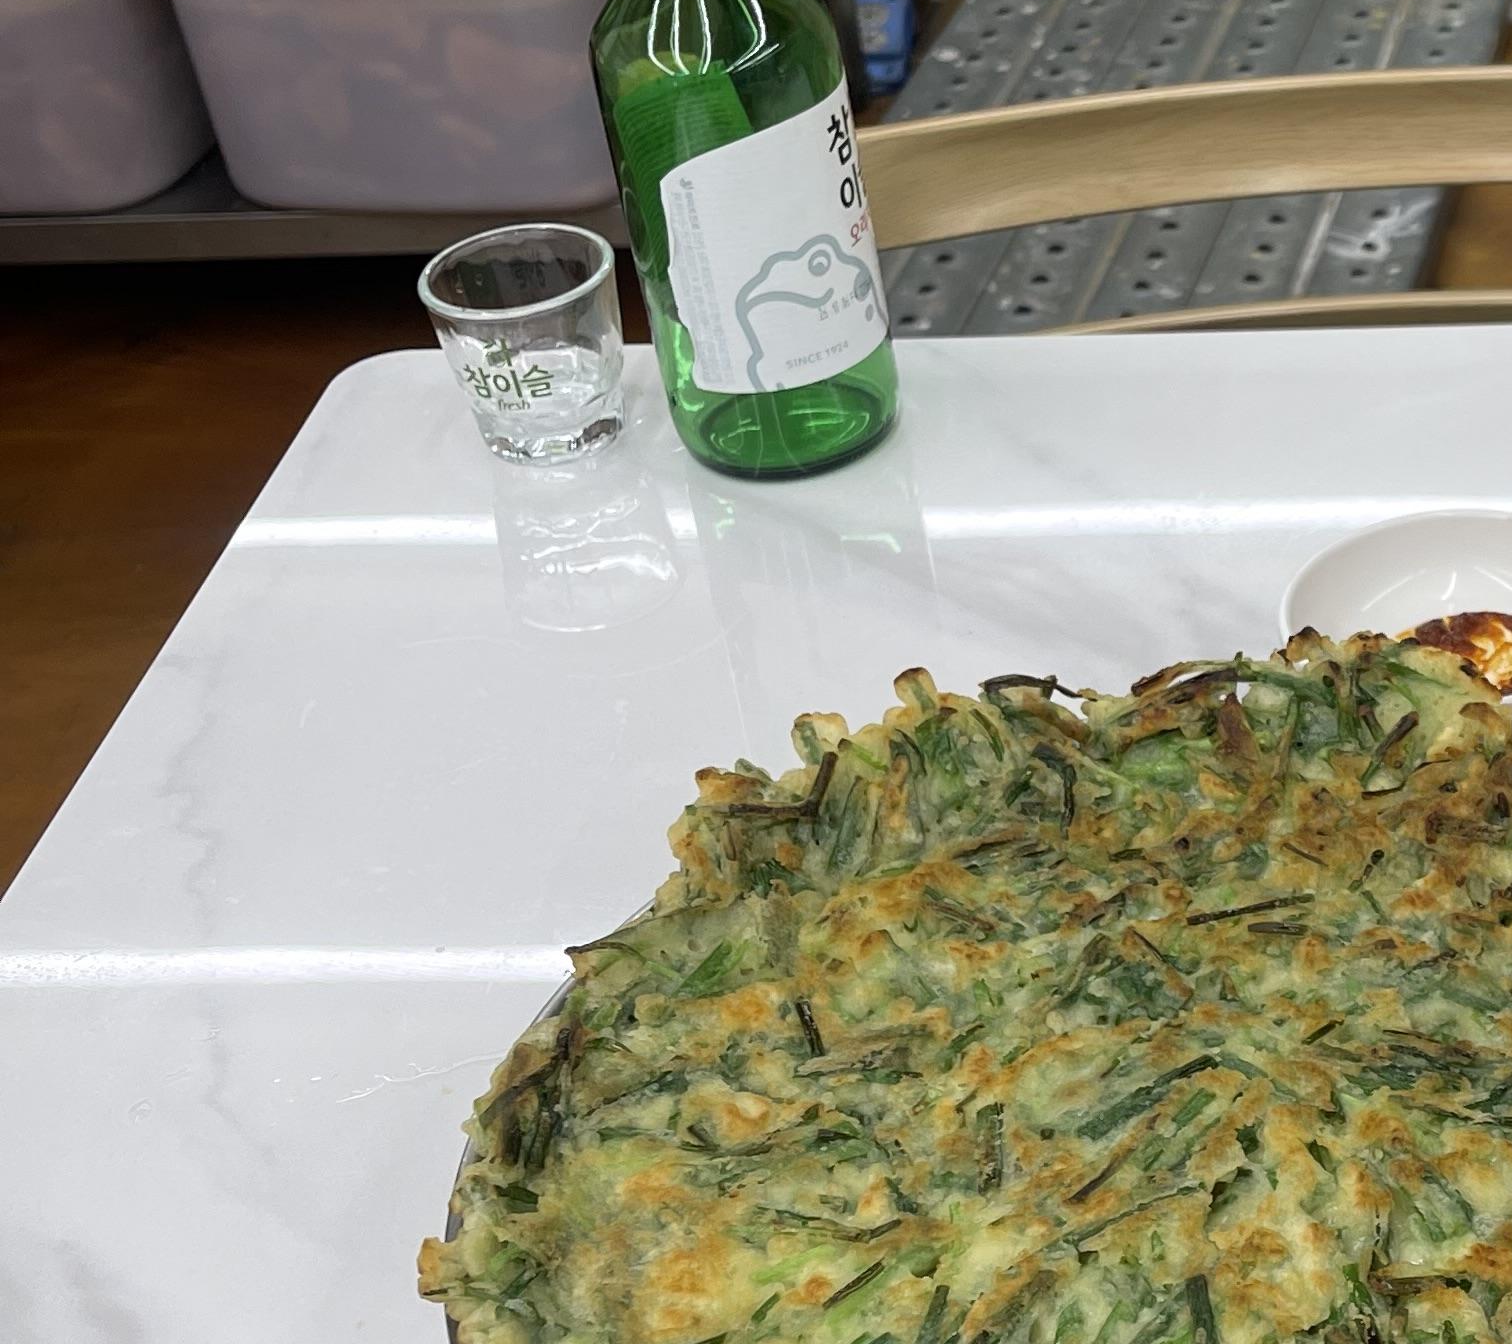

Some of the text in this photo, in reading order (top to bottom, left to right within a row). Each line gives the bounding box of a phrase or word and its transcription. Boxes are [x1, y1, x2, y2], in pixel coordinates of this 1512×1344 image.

[840, 162, 867, 209] 이
[785, 351, 824, 370] SINCE
[463, 363, 555, 399] 참이슬
[498, 399, 531, 411] fresh
